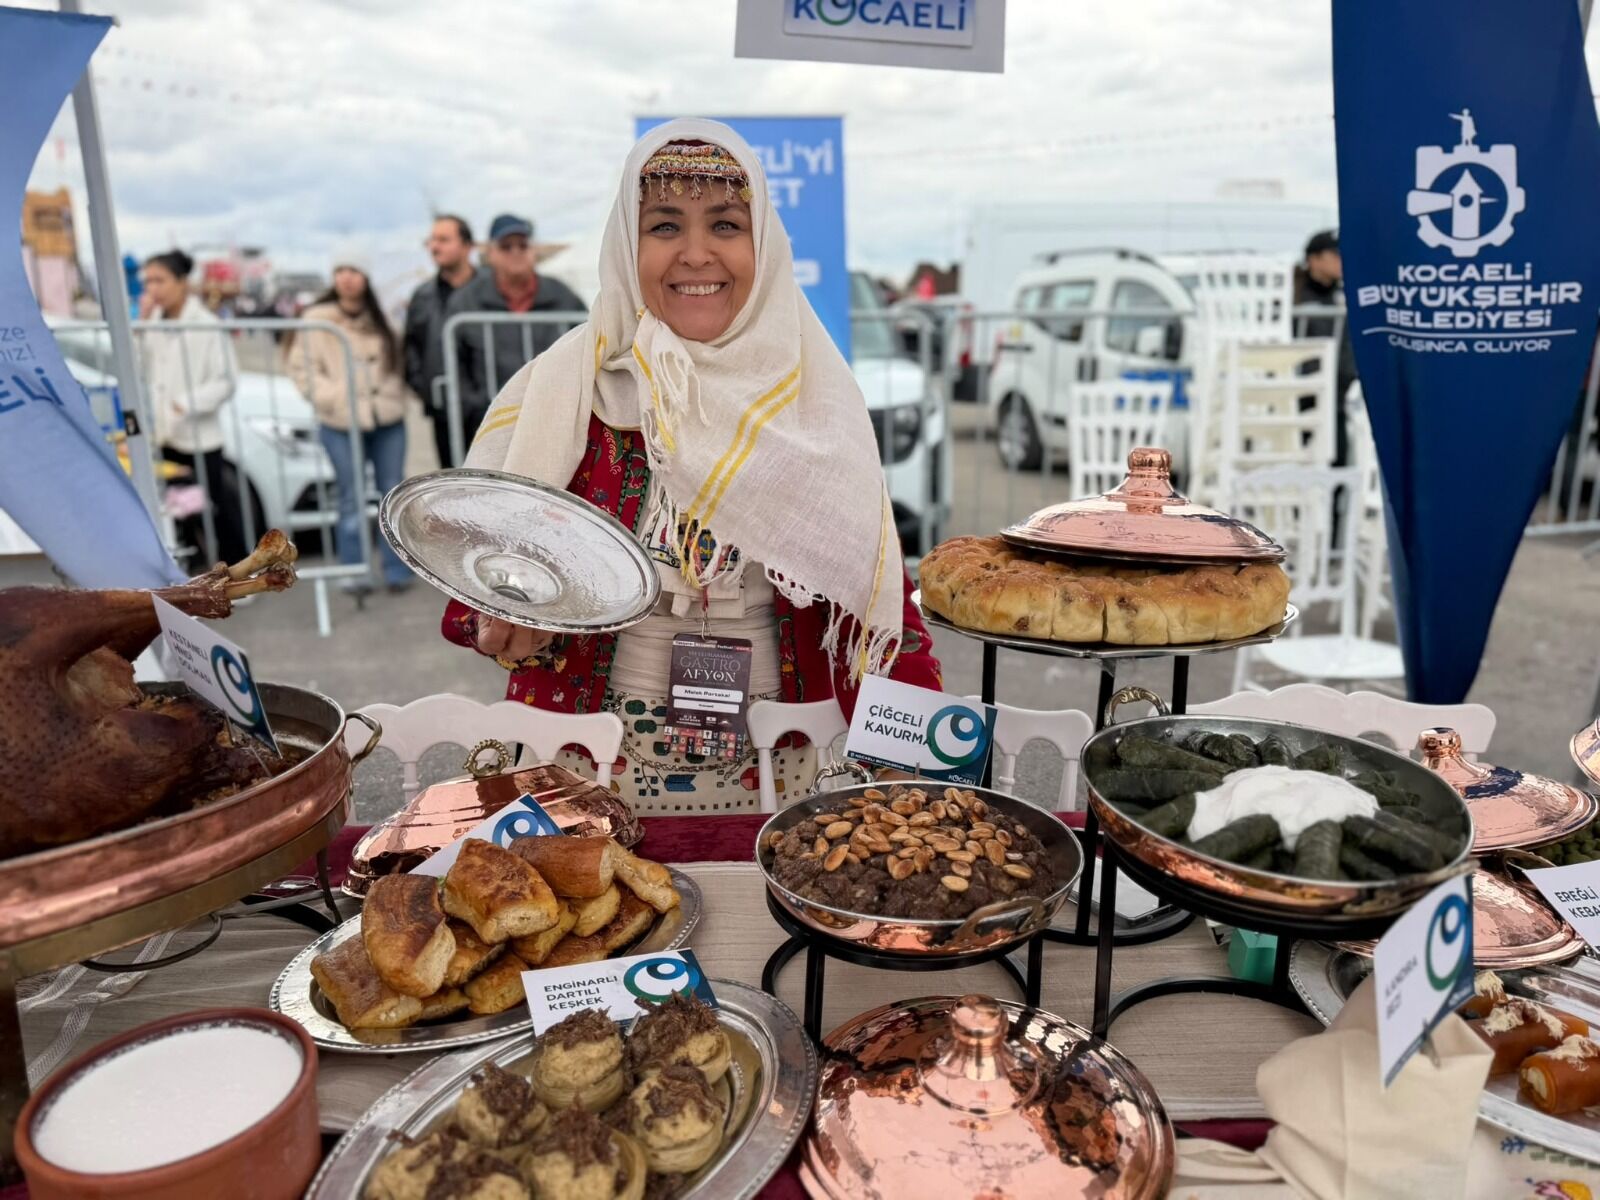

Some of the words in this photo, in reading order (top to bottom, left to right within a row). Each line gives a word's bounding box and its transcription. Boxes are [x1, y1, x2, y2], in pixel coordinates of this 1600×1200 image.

[793, 0, 967, 31] KOCAELİ
[1397, 262, 1532, 283] KOCAELİ
[1356, 281, 1583, 310] BÜYÜKŞEHİR
[1385, 307, 1553, 330] BELEDİYESİ
[1473, 338, 1552, 353] OLUYOR
[680, 655, 741, 672] GASTRO
[682, 668, 736, 683] AFYON
[869, 704, 924, 728] ÇİĞCELİ
[1554, 886, 1599, 903] EREĞLİ
[1568, 904, 1600, 918] KEBA
[544, 975, 618, 993] ENGİNARLI
[549, 997, 605, 1012] KEŞKEK
